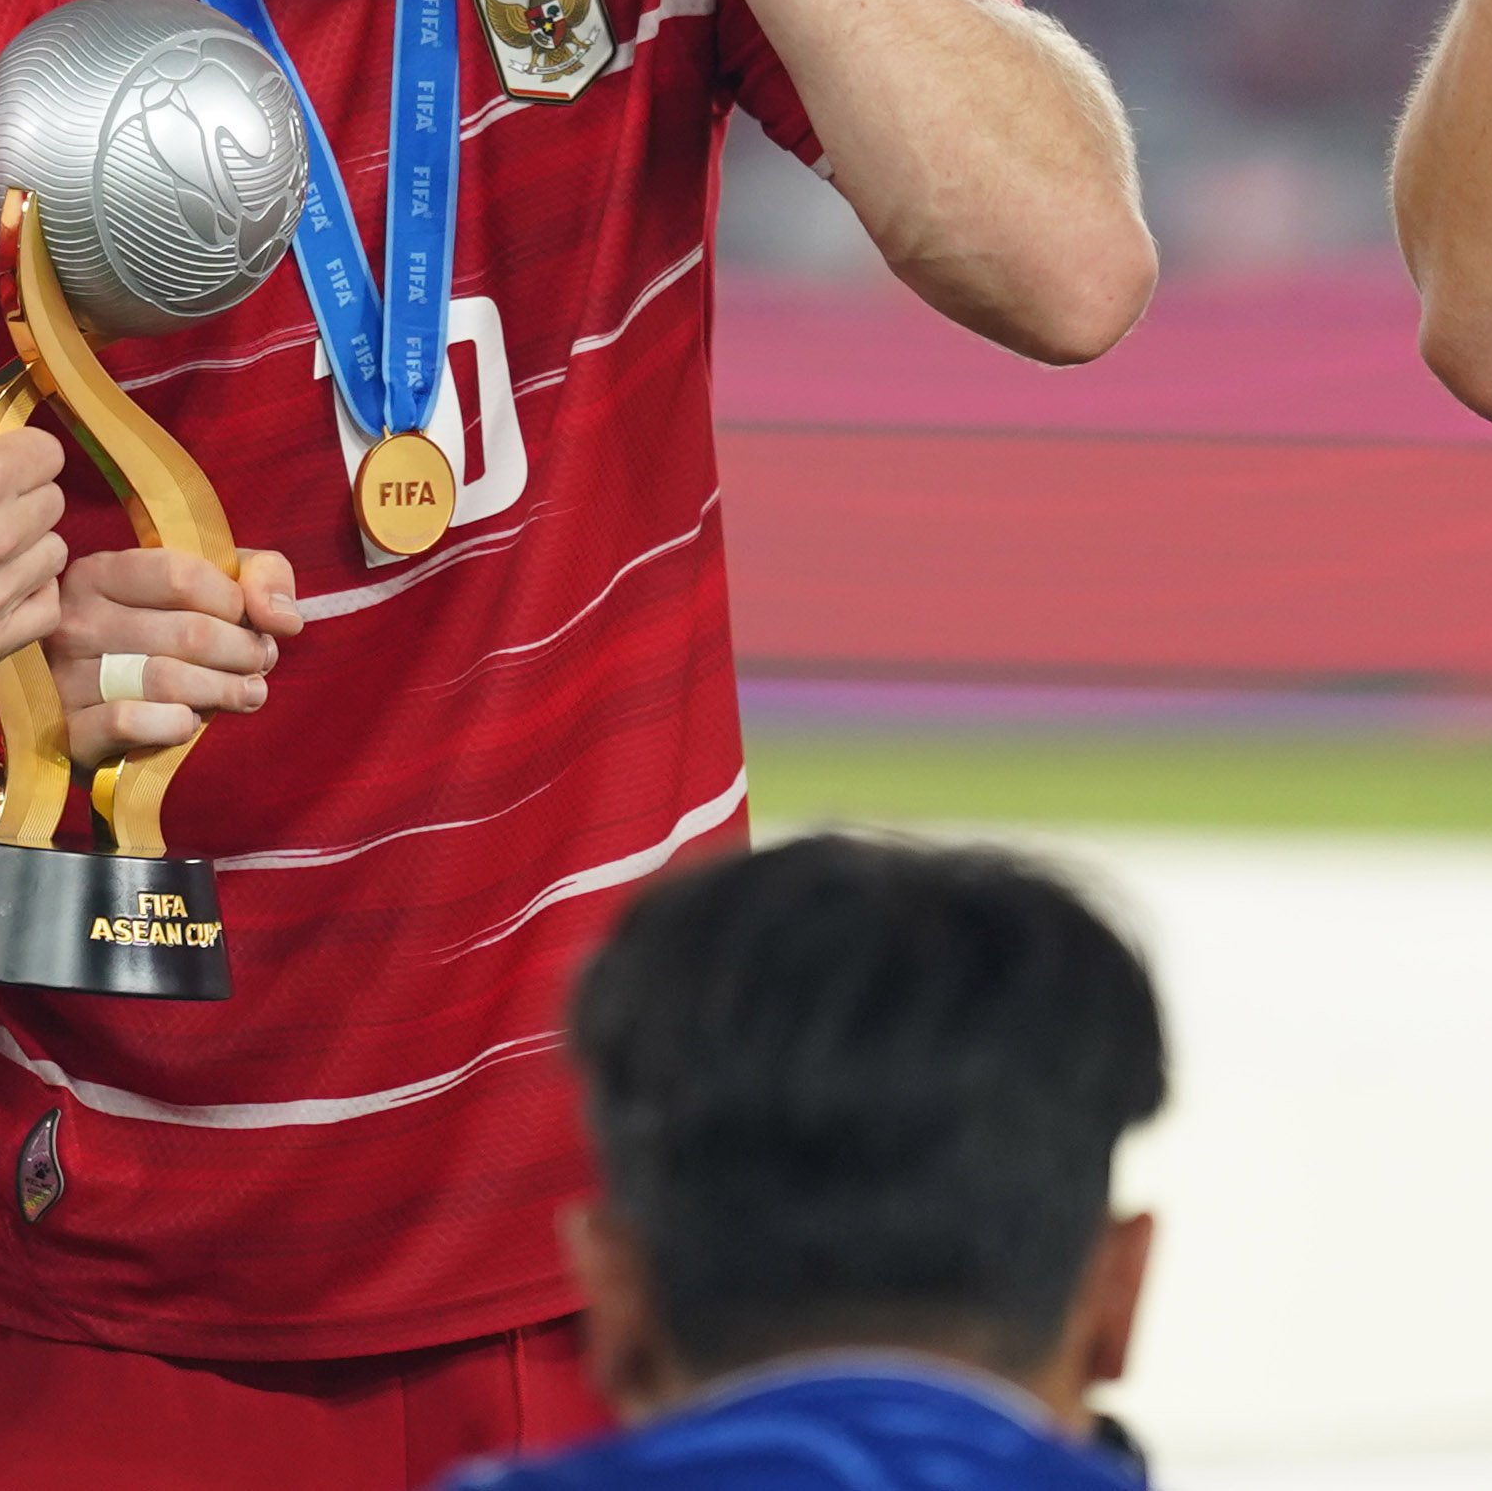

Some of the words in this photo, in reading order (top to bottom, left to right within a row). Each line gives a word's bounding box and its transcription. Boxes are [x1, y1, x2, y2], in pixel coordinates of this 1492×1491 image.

[415, 80, 436, 132] FIFA
[305, 182, 330, 234] FIFA
[411, 165, 431, 218] FIFA
[326, 257, 354, 309] FIFA
[408, 251, 427, 303] FIFA
[350, 333, 376, 382] FIFA
[406, 336, 423, 389] FIFA
[379, 481, 437, 507] FIFA
[90, 917, 183, 946] ASEAN
[137, 892, 189, 919] FIFA
